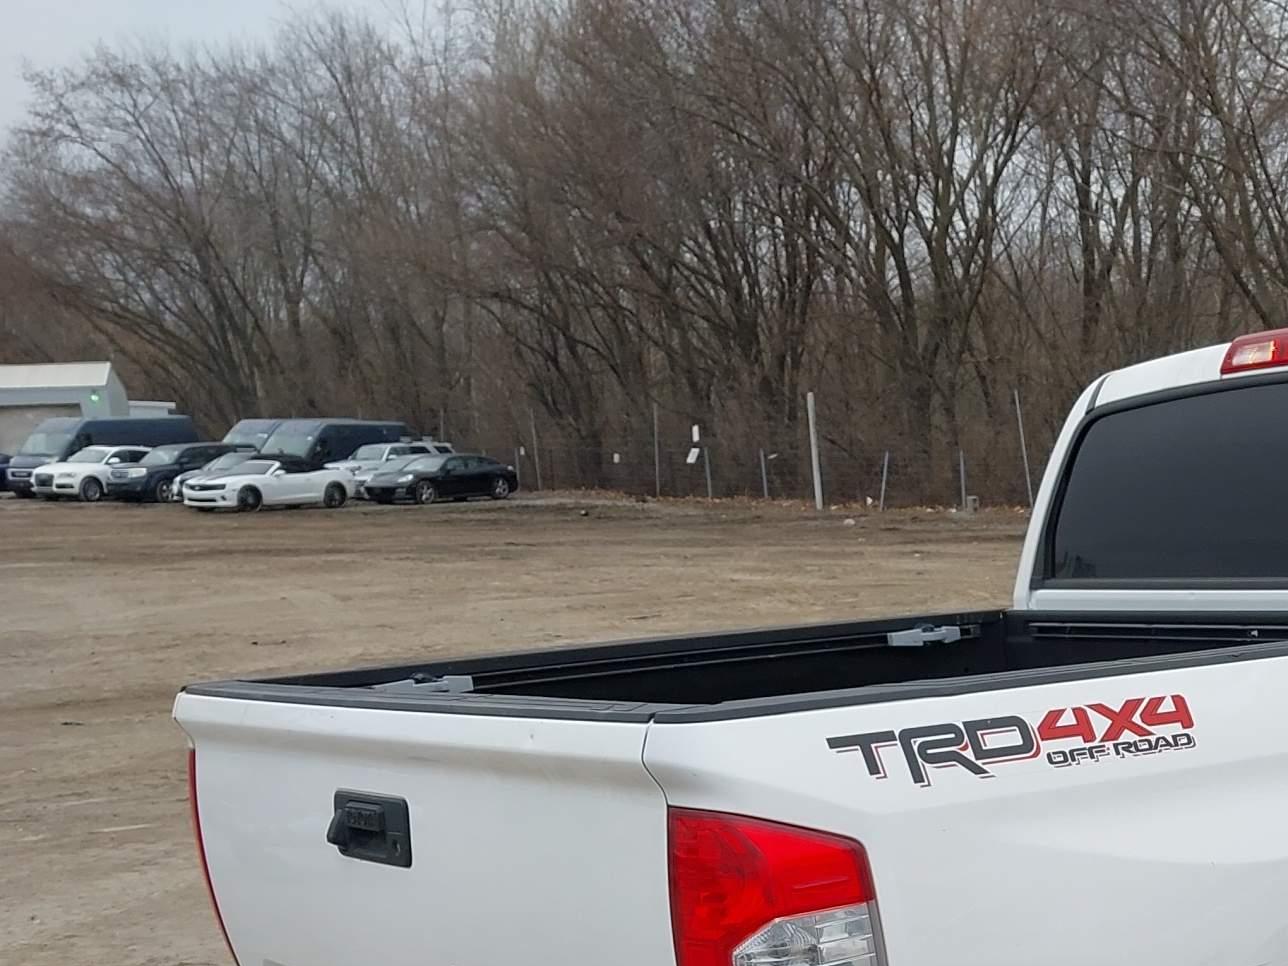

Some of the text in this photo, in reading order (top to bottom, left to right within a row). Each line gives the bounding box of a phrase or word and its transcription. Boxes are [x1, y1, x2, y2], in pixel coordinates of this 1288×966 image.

[826, 715, 1041, 787] TRD
[1046, 732, 1197, 768] OFF ROAD
